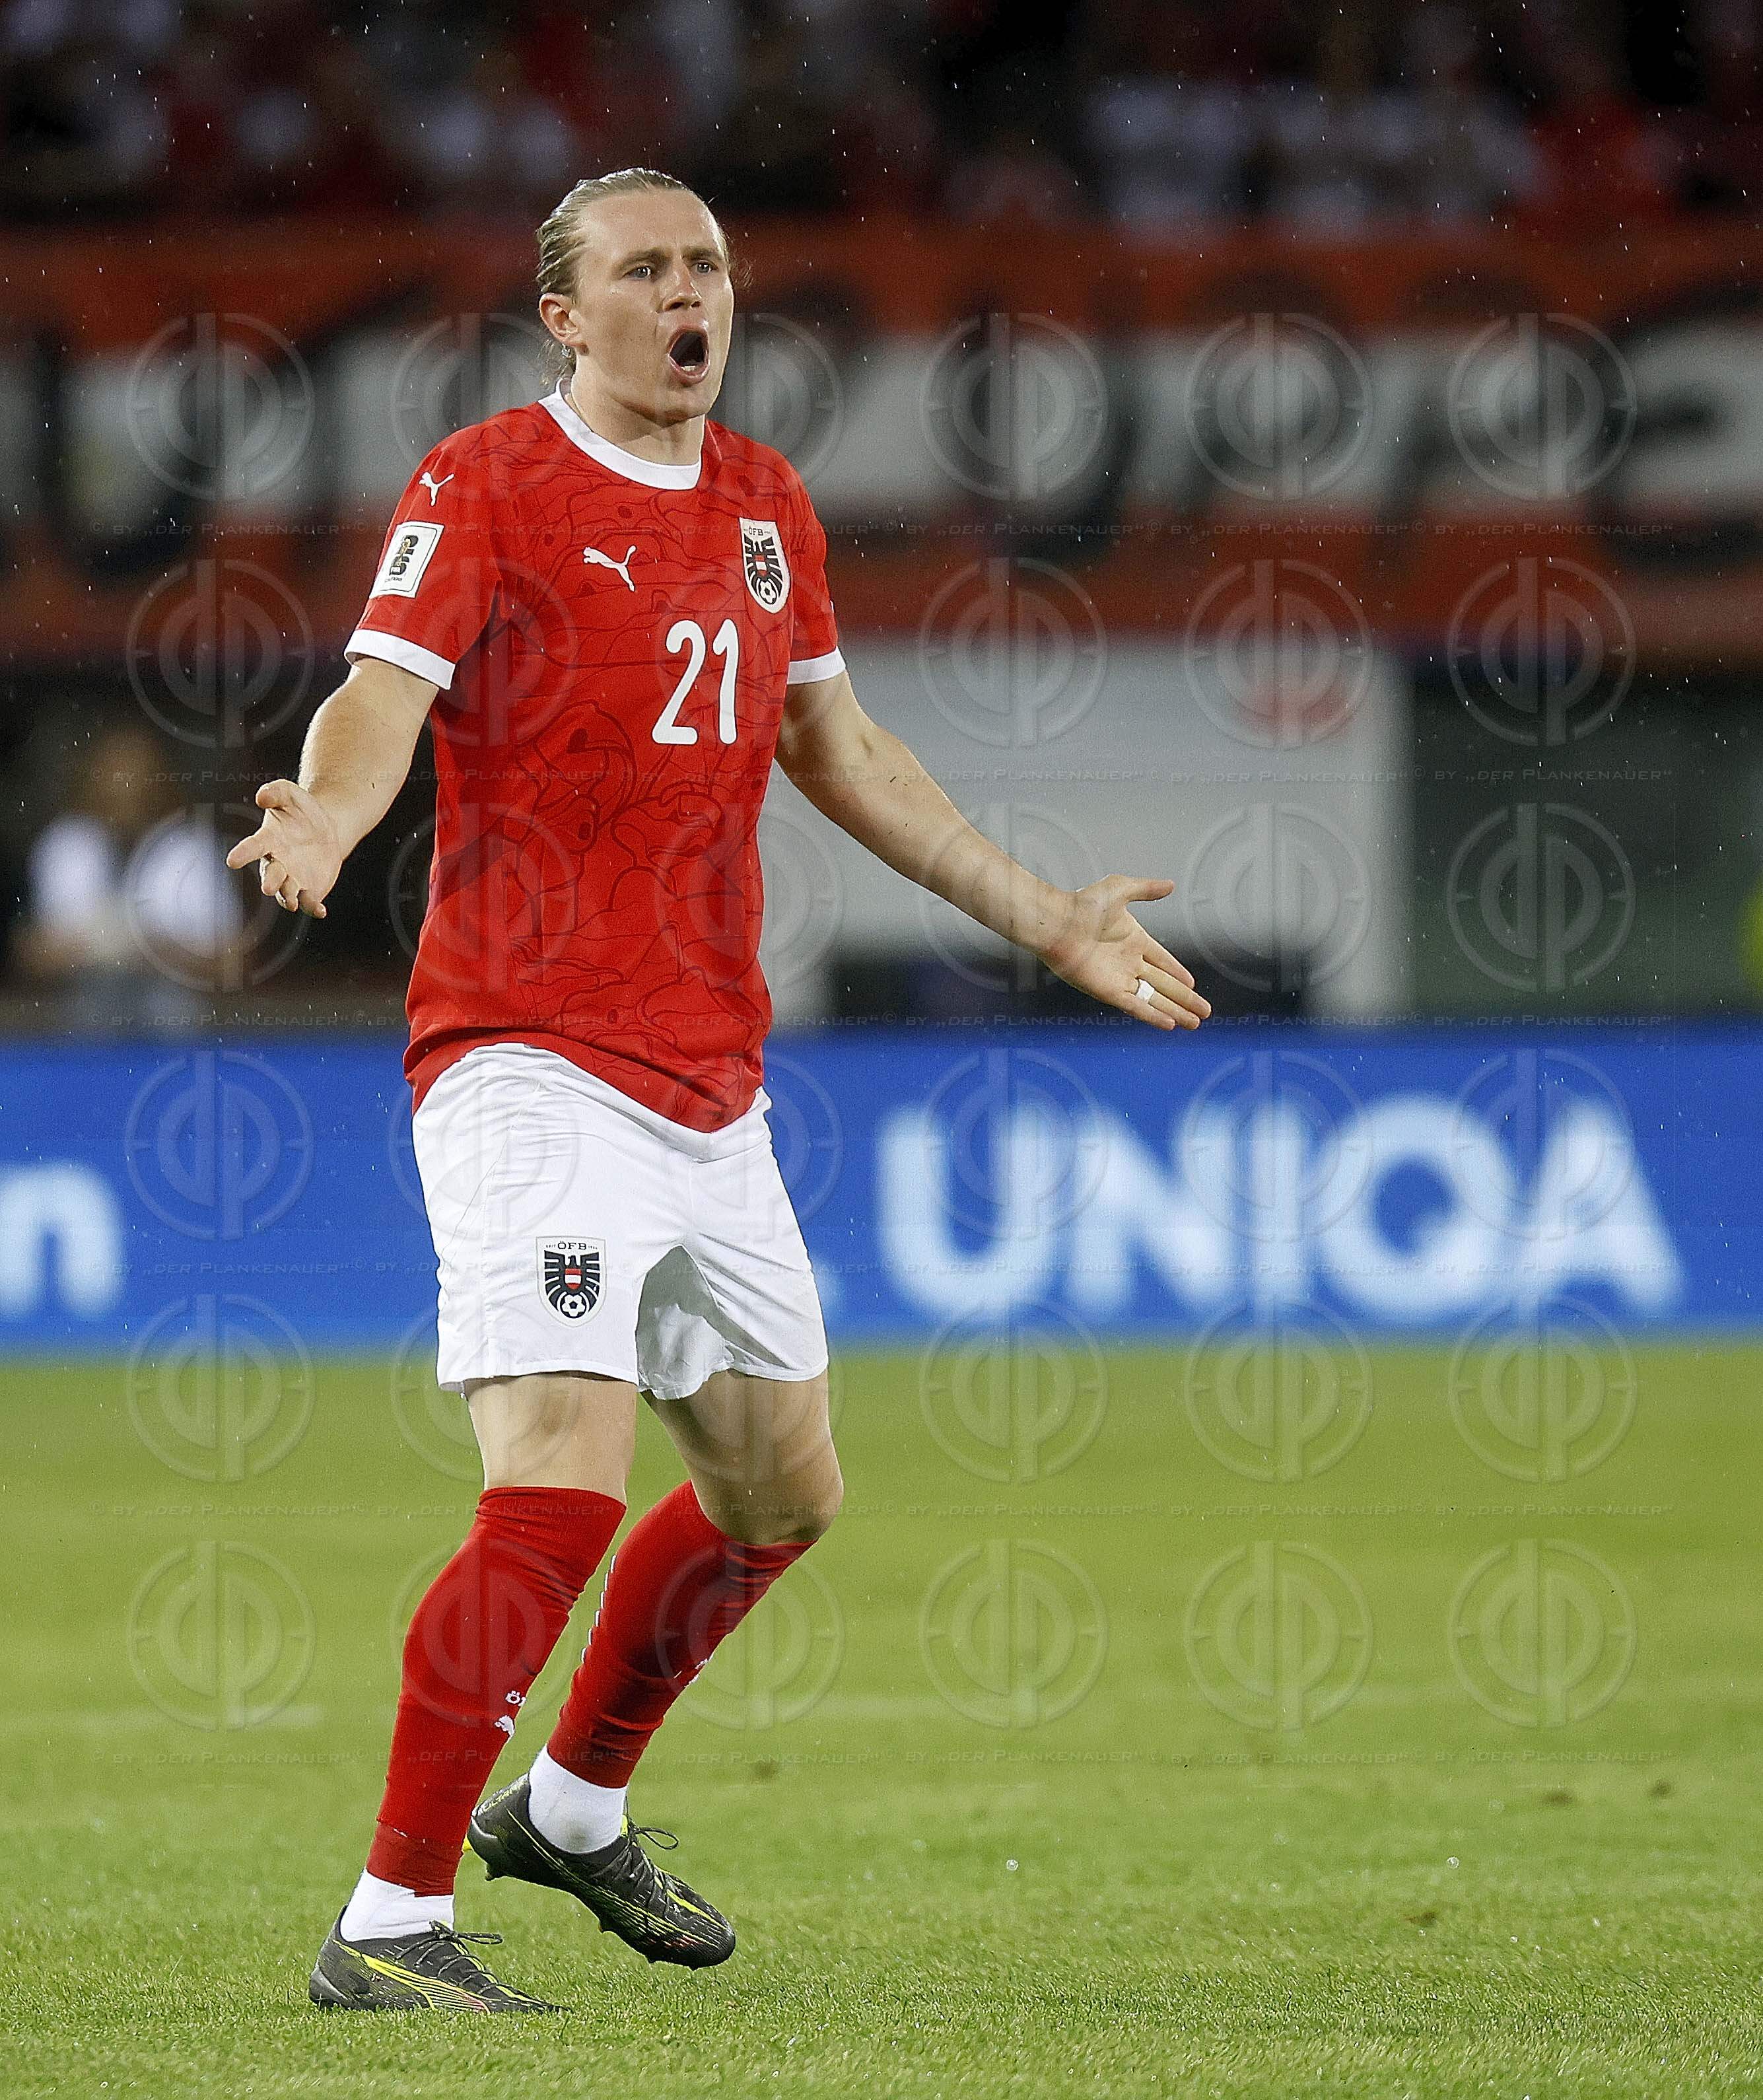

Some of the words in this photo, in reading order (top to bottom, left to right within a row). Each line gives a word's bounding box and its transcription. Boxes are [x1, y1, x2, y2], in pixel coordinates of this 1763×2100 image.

[652, 619, 740, 745] 21
[557, 1241, 586, 1249] ÖFB
[880, 1094, 1681, 1318] UNIQA
